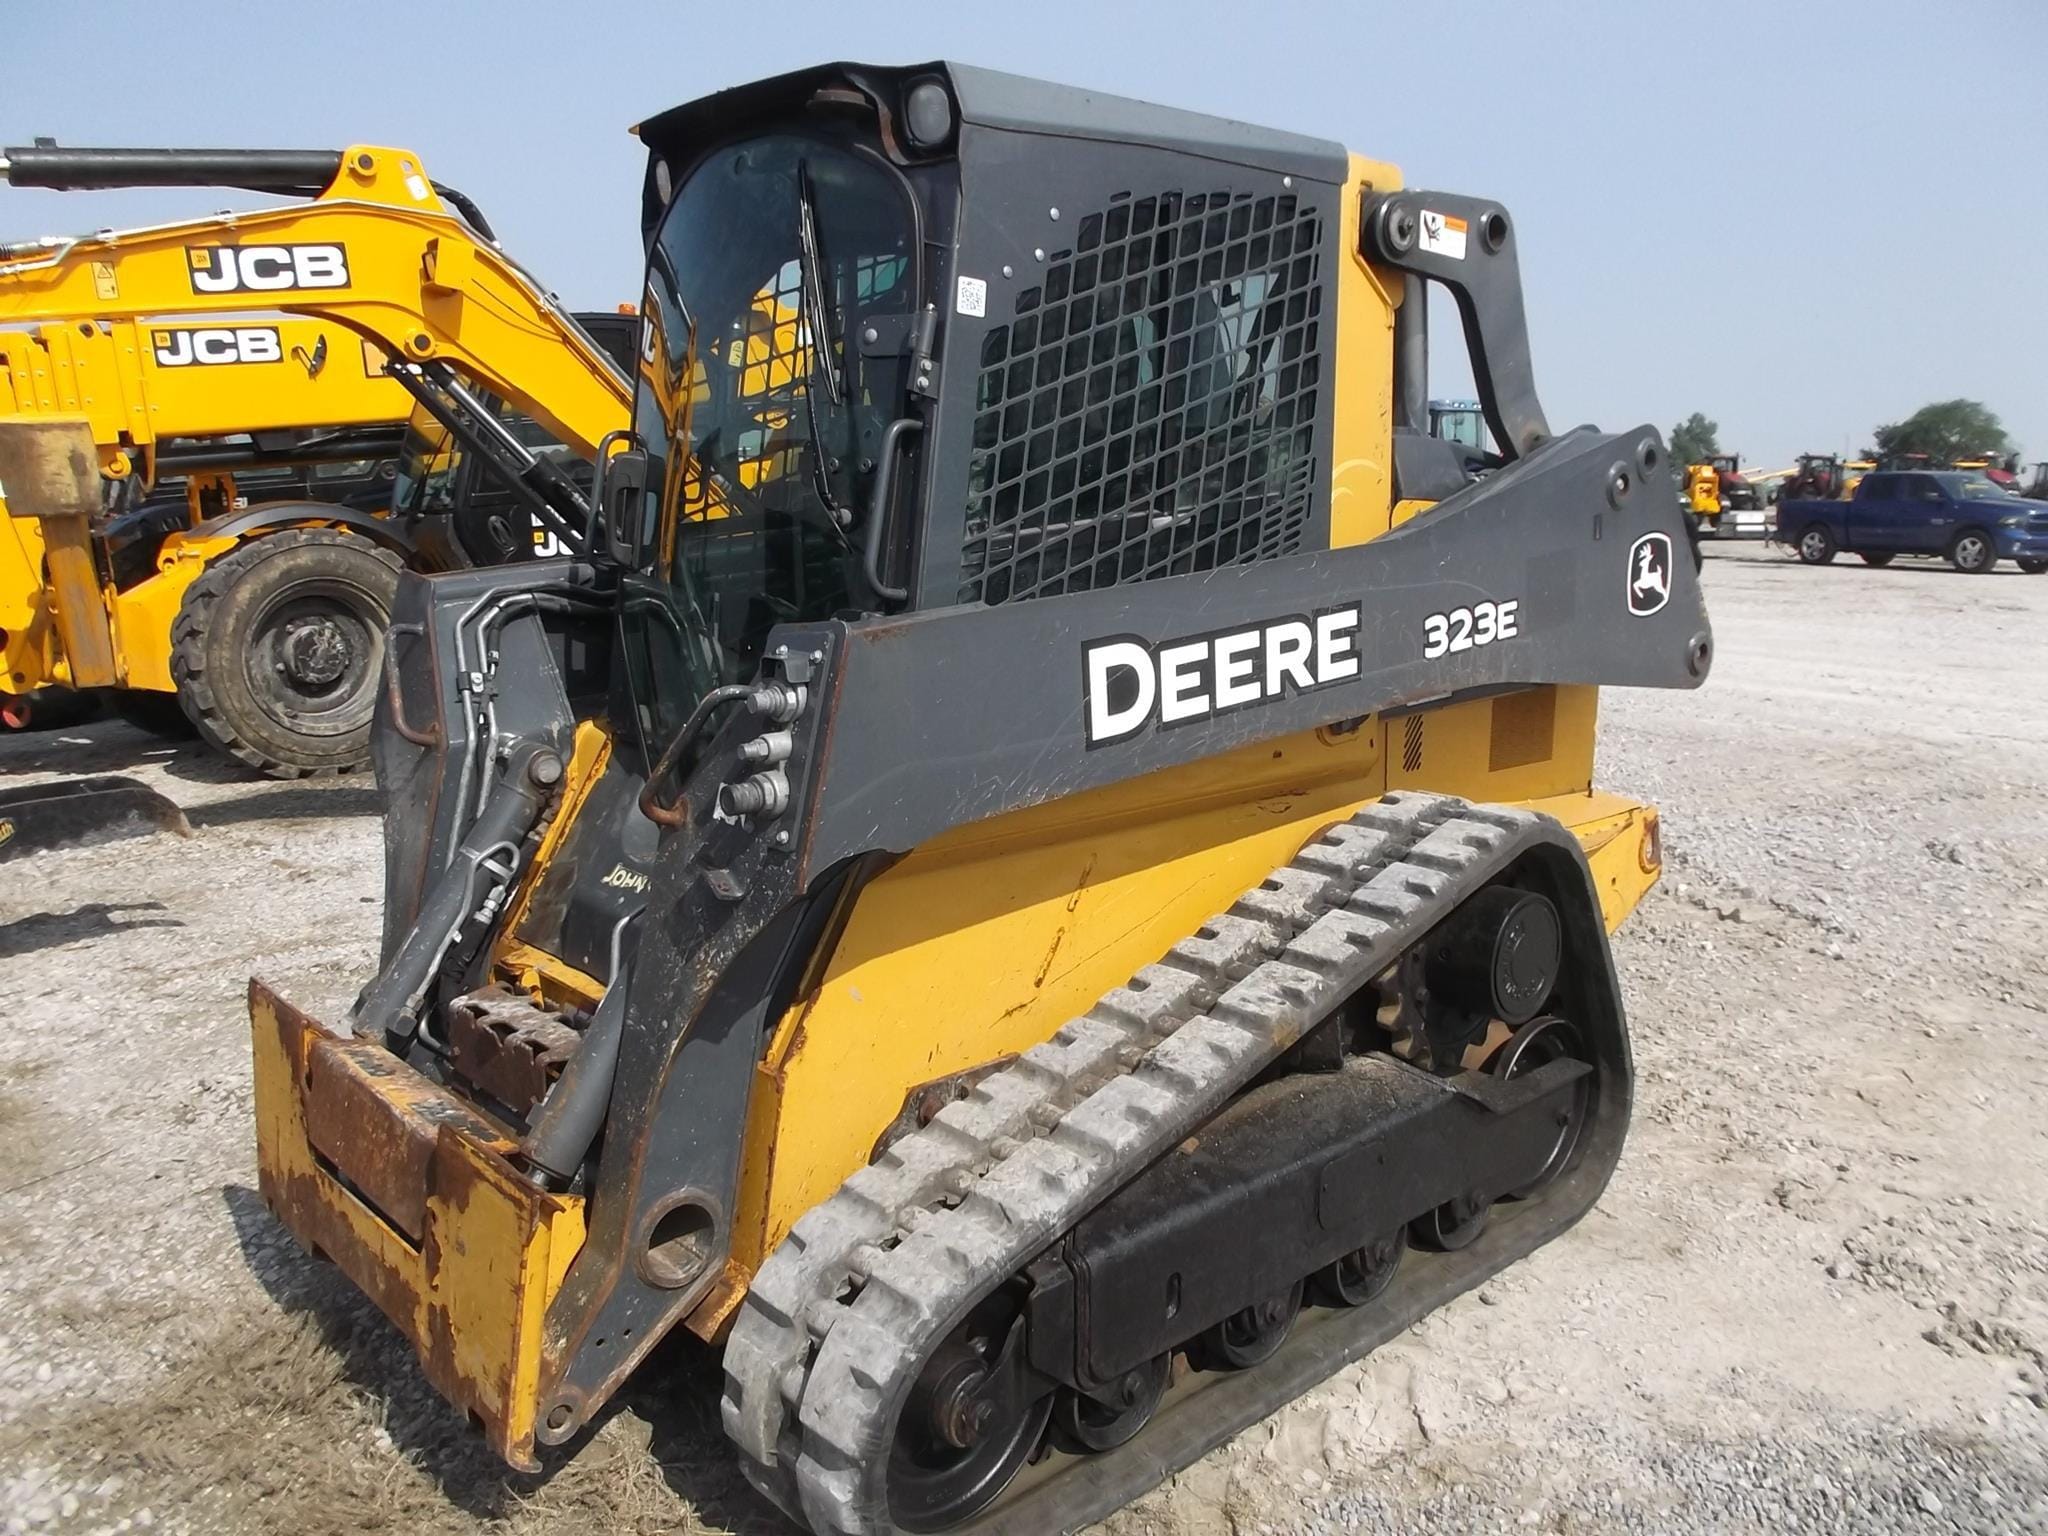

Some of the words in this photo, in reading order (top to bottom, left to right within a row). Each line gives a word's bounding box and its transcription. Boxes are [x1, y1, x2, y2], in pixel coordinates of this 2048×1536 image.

[192, 246, 348, 291] JCB
[156, 329, 281, 365] JCB
[1423, 600, 1519, 659] 323E
[1088, 608, 1359, 742] DEERE
[601, 862, 648, 894] JOHN
